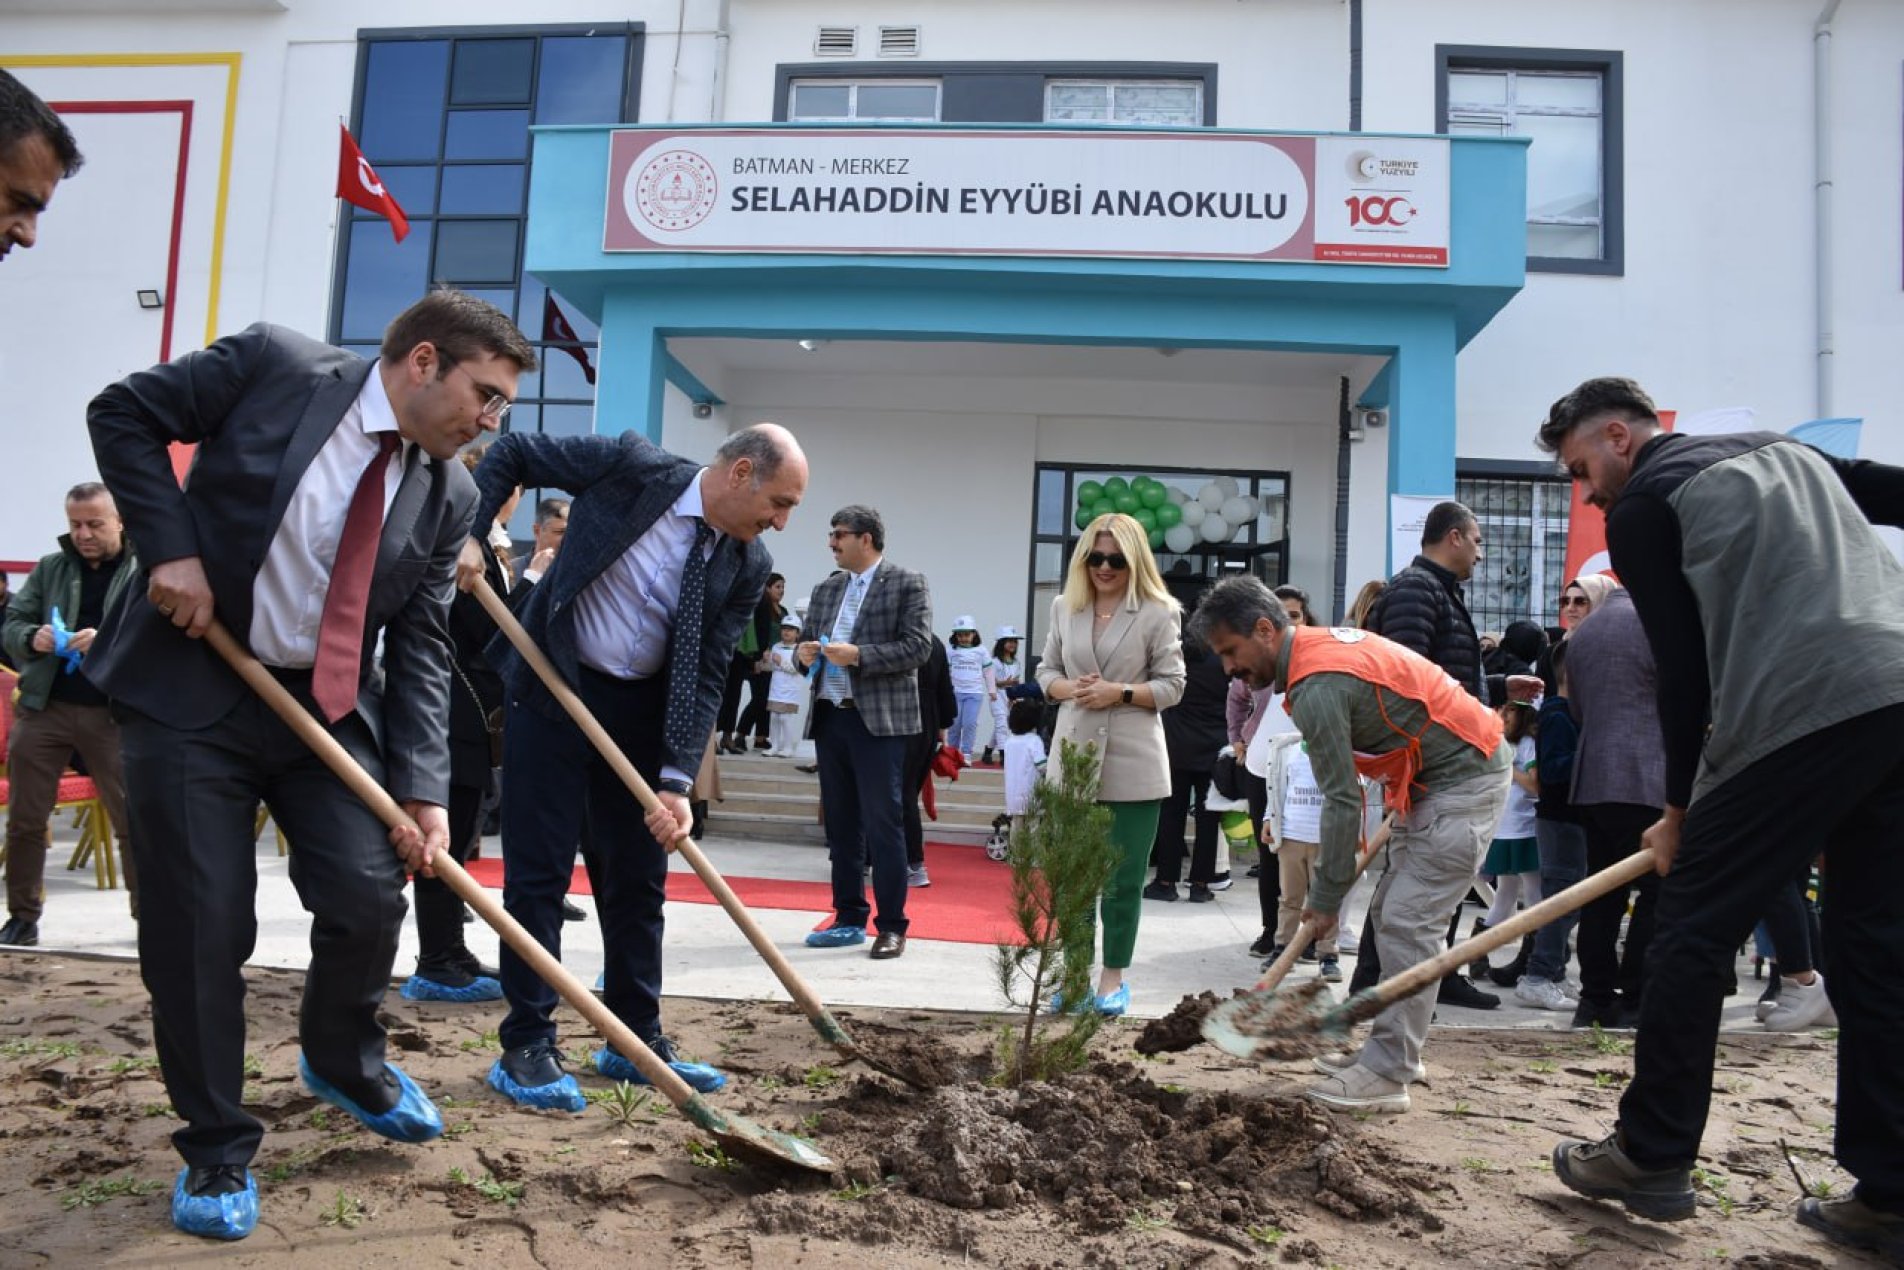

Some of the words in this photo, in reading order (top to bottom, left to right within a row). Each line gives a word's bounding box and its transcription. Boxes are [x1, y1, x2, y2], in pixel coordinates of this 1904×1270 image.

[732, 158, 814, 175] BATMAN
[831, 158, 909, 175] MERKEZ
[731, 181, 949, 213] SELAHADDİN
[960, 183, 1081, 215] EYYÜBİ
[1091, 189, 1287, 220] ANAOKULU
